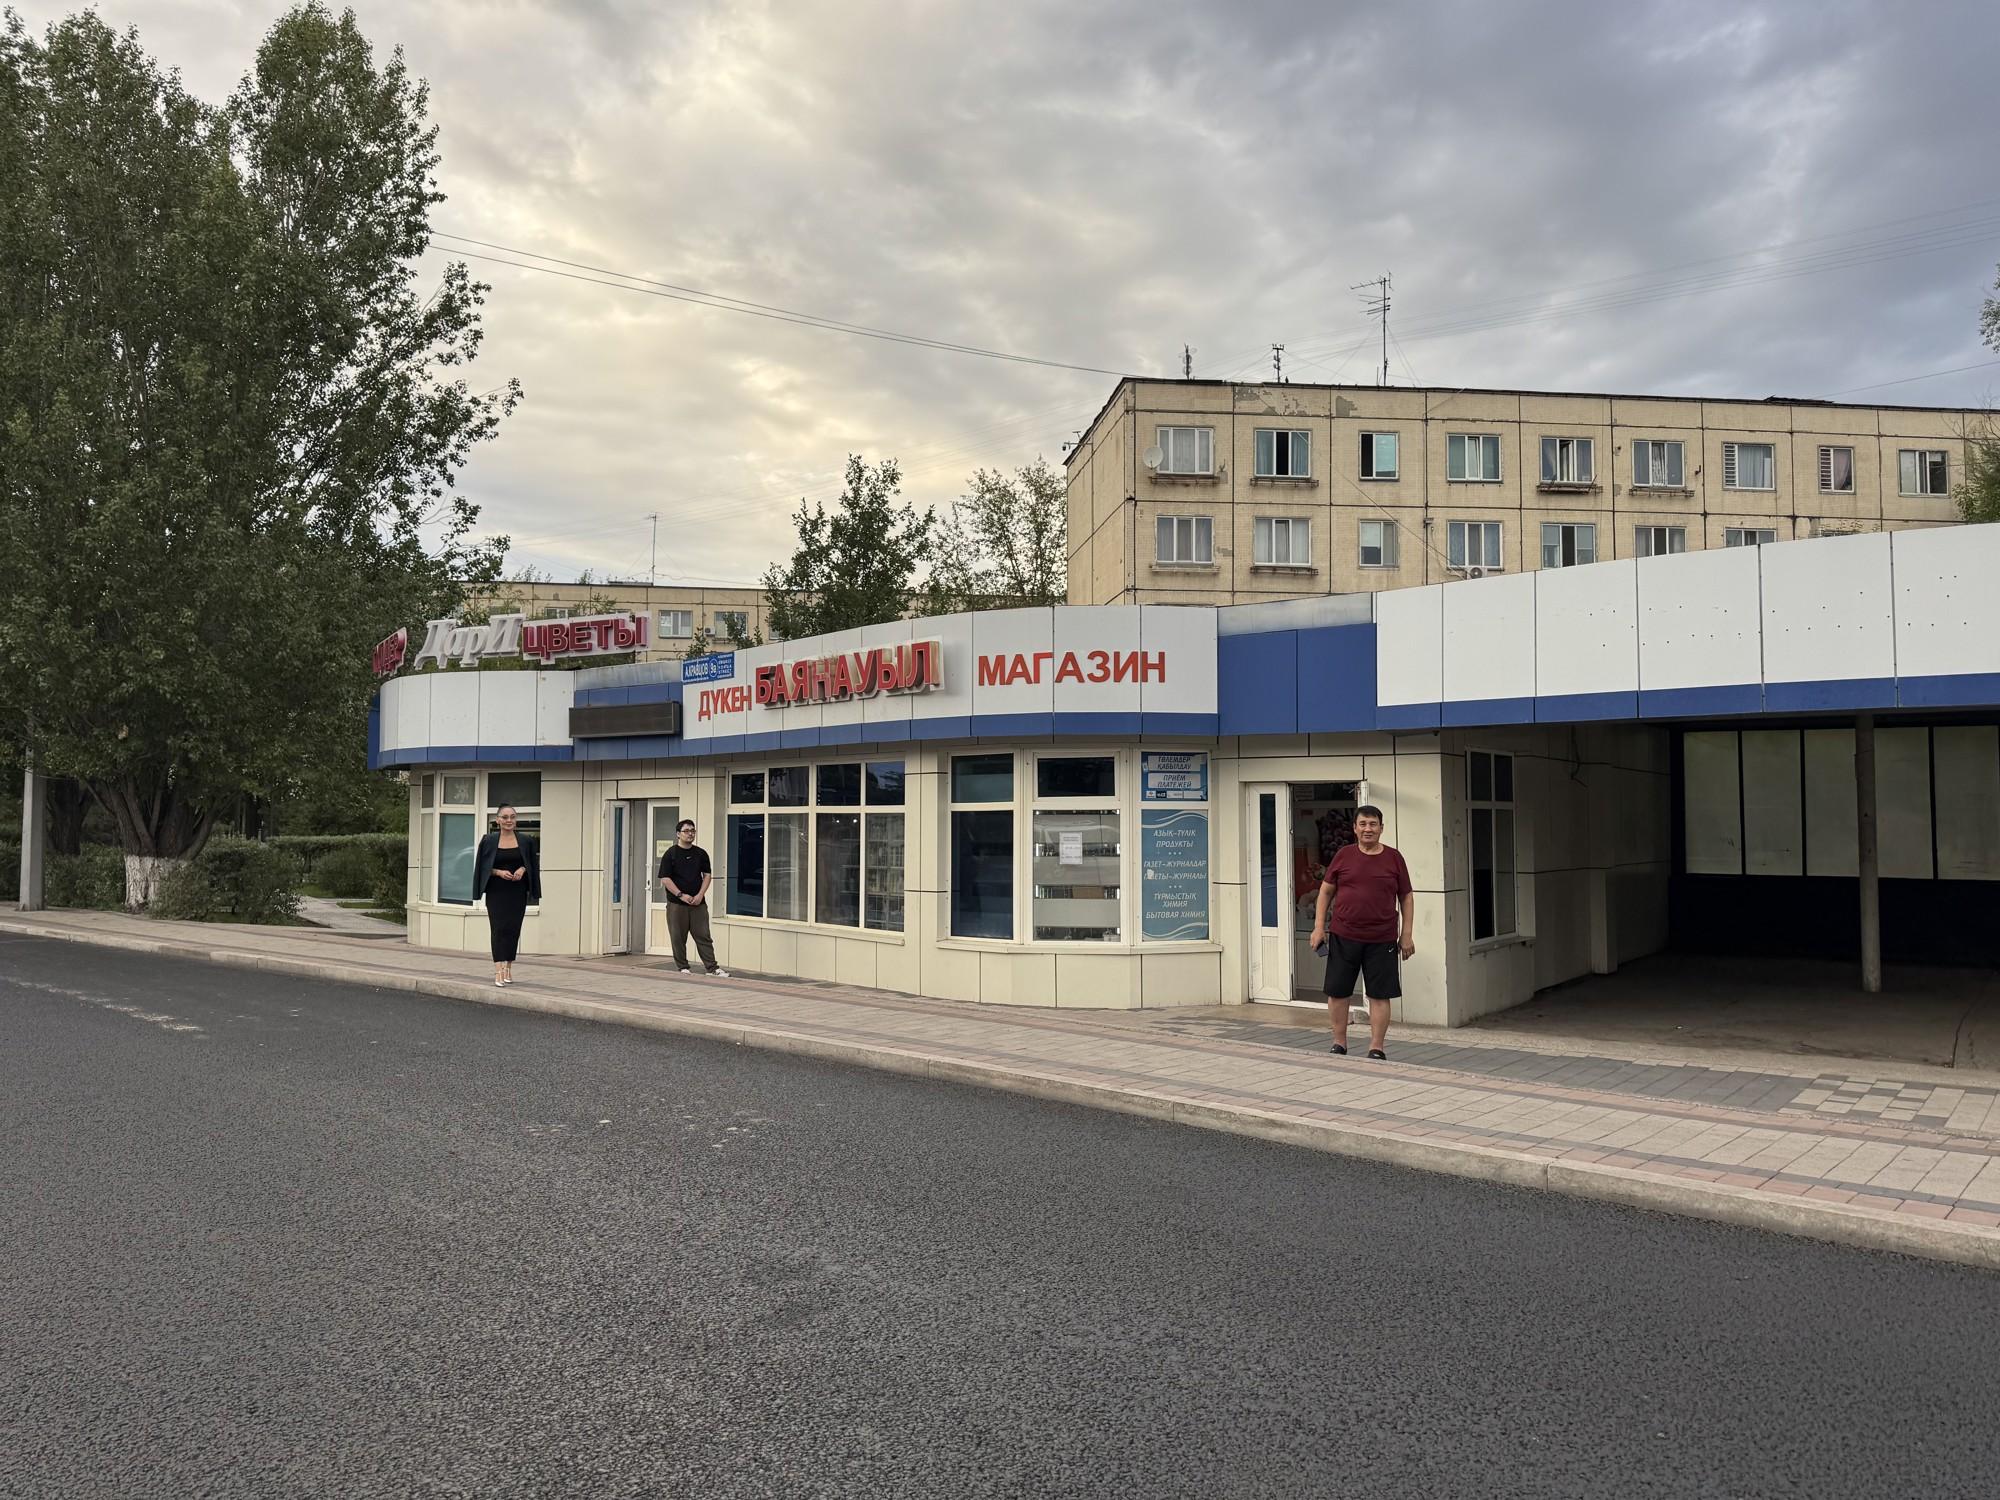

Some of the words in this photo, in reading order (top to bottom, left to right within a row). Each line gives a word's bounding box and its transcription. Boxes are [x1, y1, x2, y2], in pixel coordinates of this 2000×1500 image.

[522, 616, 648, 660] ЦВЕТЫ
[978, 650, 1166, 687] МАГАЗИН
[698, 685, 752, 721] ДҮКЕН
[755, 640, 939, 704] БАЯНАУЫЛ
[1155, 840, 1194, 848] ПРОДУКТЫ
[1145, 911, 1179, 919] БЫТОВАЯ
[1180, 910, 1206, 919] ХИМИЯ
[1162, 900, 1188, 908] ХИМИЯ
